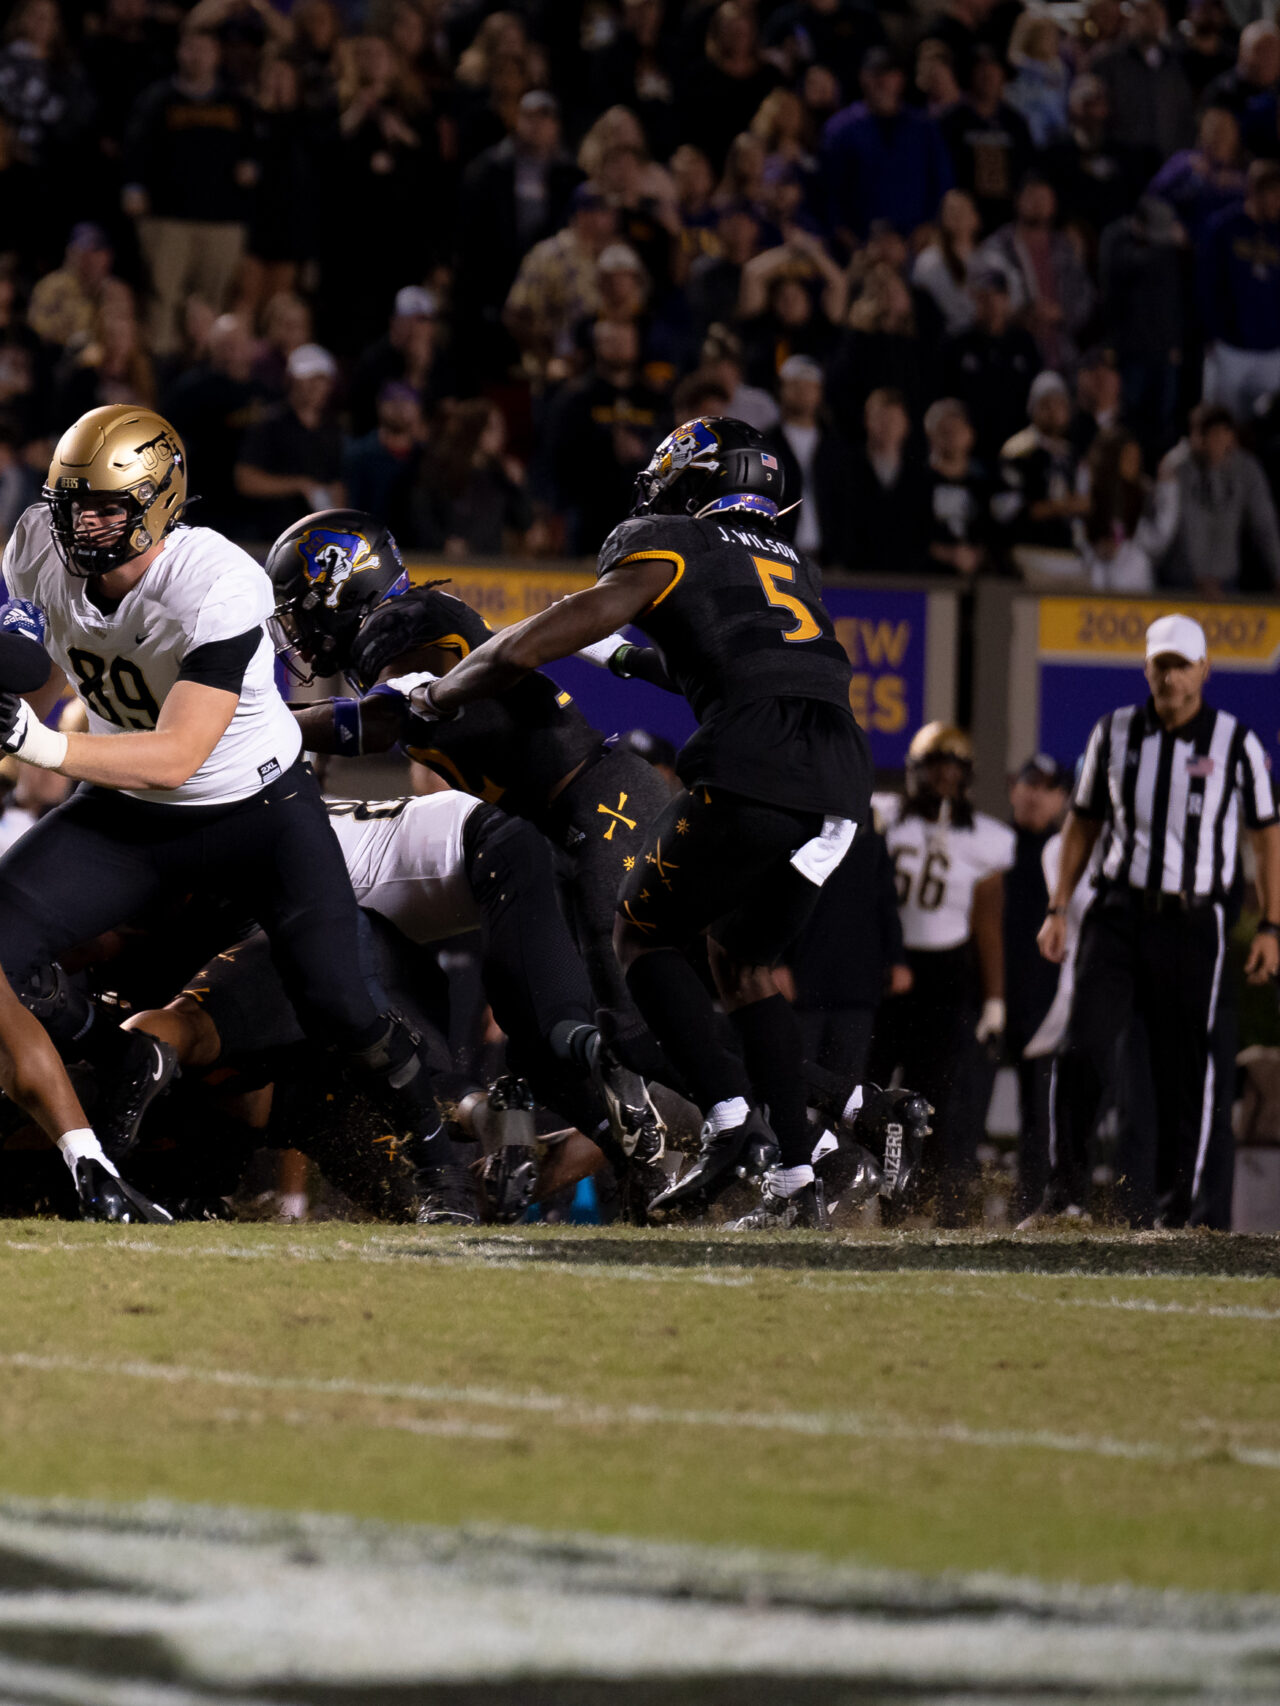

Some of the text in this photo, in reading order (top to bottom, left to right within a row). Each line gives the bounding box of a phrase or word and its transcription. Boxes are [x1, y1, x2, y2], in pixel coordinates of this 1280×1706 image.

[3, 614, 36, 627] adidas
[749, 554, 823, 643] 5
[833, 616, 910, 668] EW
[68, 648, 161, 730] 89
[261, 760, 278, 775] 2XL
